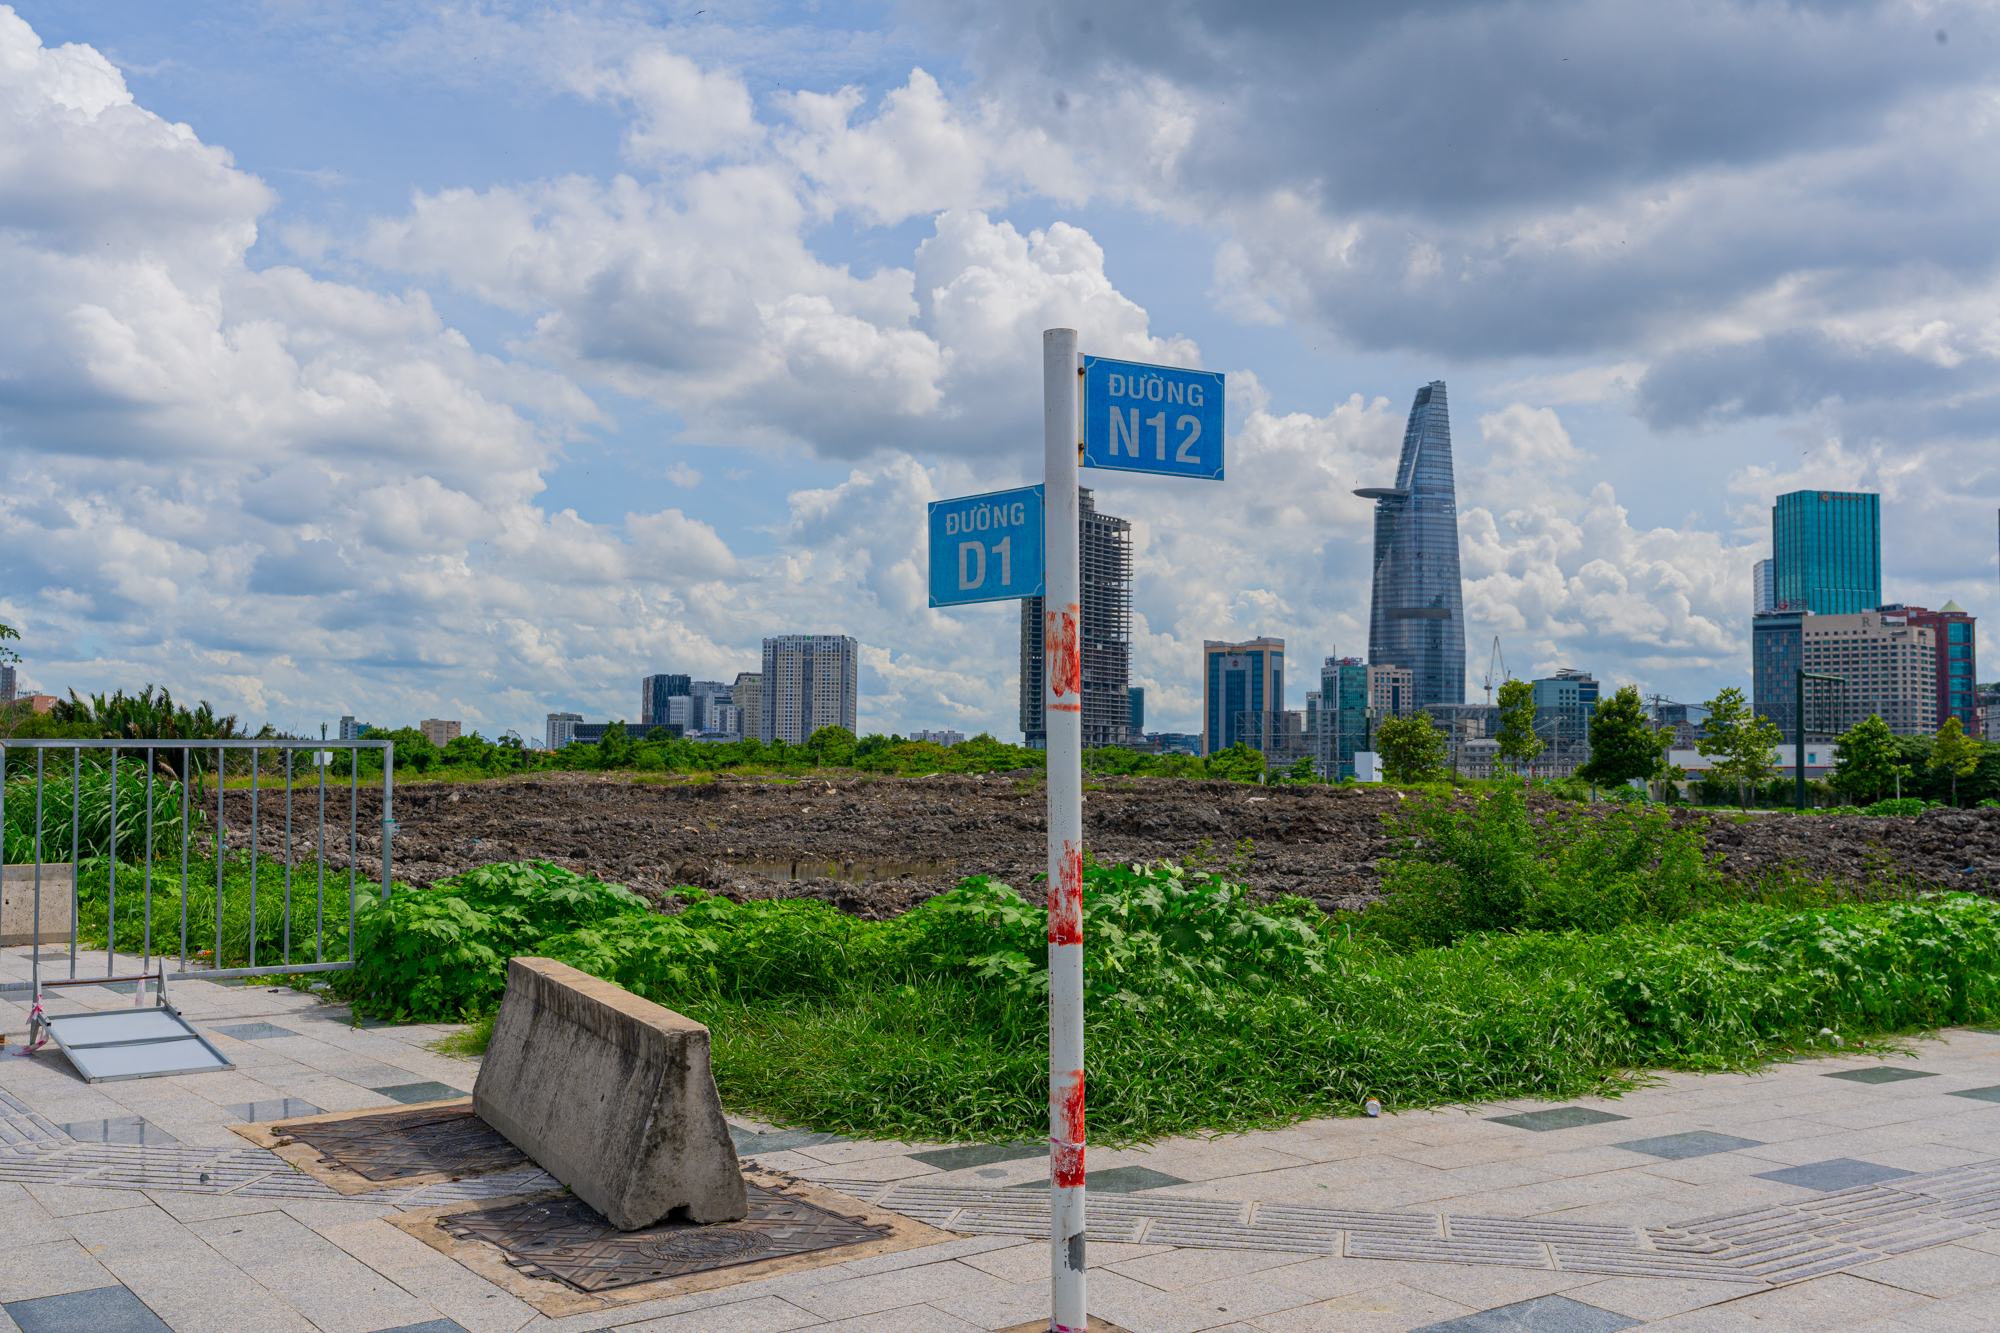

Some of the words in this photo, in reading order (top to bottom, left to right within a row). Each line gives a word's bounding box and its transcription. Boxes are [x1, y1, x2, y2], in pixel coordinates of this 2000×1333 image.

[1108, 373, 1204, 407] ĐƯỜNG
[1109, 406, 1202, 464] N12
[946, 502, 1025, 535] ĐƯỜNG
[958, 536, 1011, 590] D1
[1862, 616, 1872, 627] R
